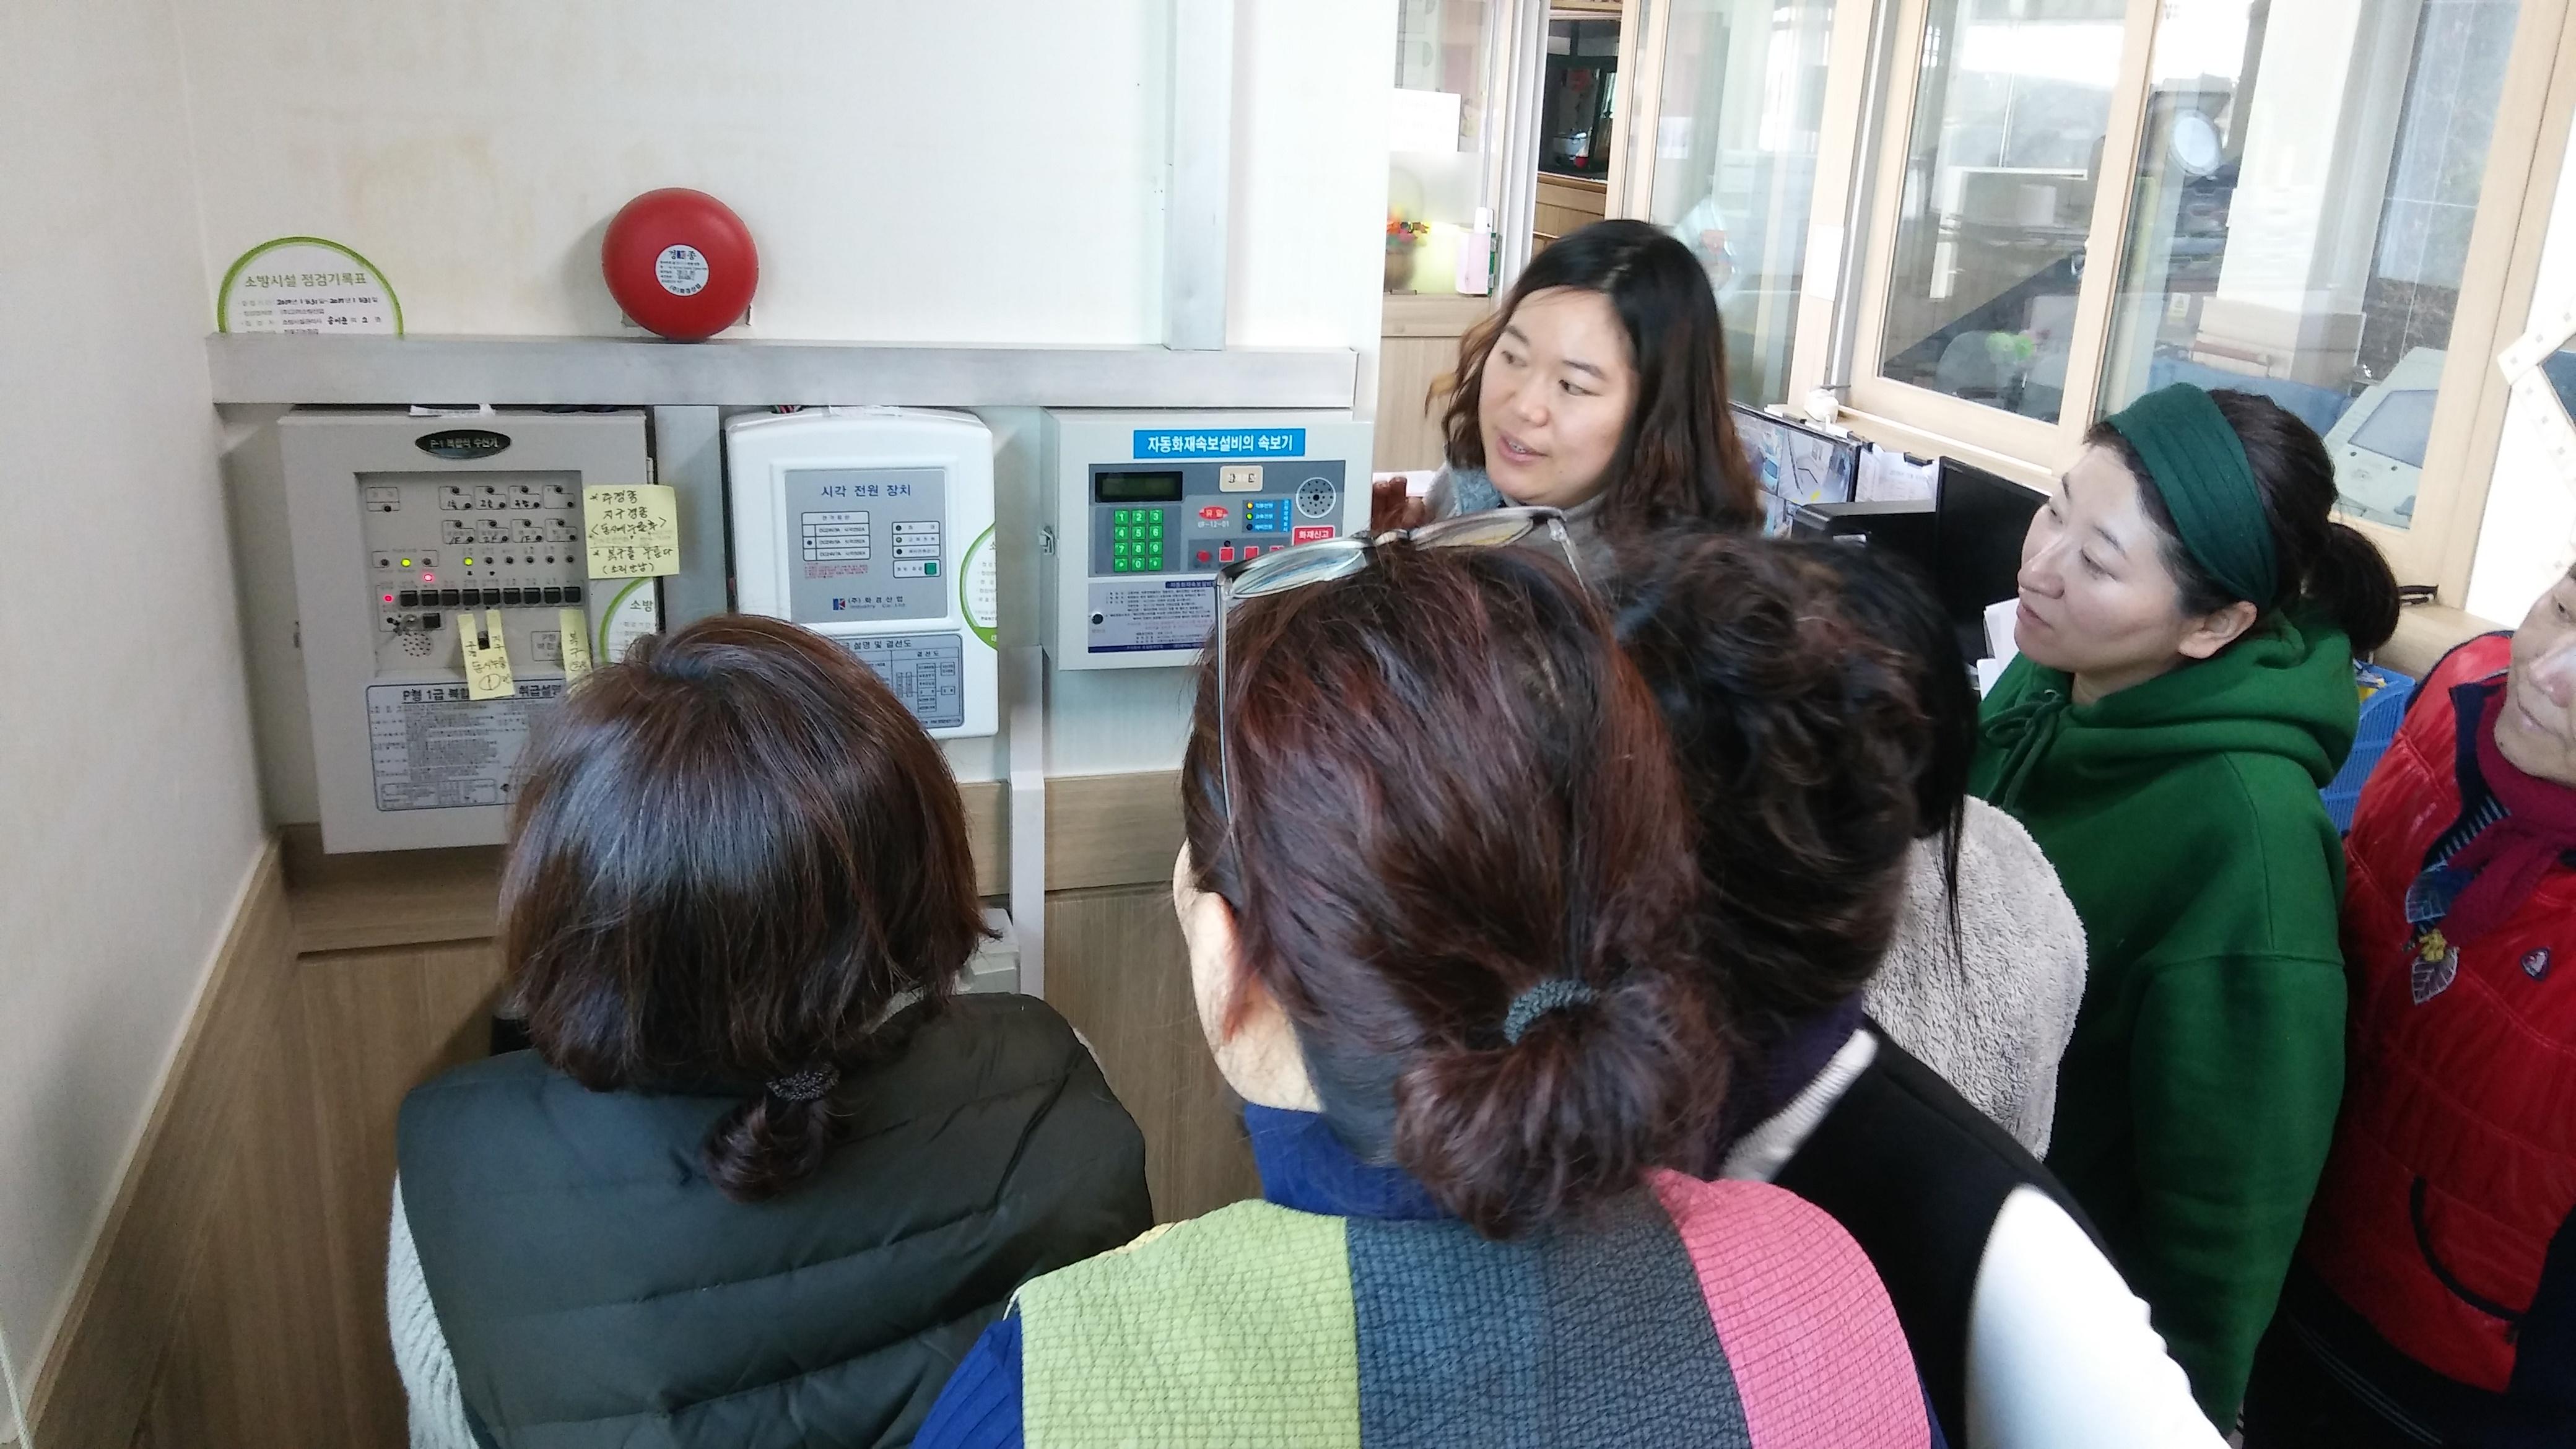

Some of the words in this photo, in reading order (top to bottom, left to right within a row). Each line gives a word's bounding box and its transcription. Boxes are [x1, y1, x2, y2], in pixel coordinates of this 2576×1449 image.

[245, 274, 296, 287] 소방시설
[302, 273, 366, 287] 점검기록표
[430, 439, 444, 448] P-1
[1147, 435, 1254, 453] 자동화재속보설비의
[1258, 435, 1293, 452] 속보기
[822, 485, 846, 497] 시각
[855, 484, 879, 497] 전원
[887, 484, 911, 497] 장치
[1119, 513, 1124, 521] 1
[1136, 513, 1142, 521] 2
[1153, 512, 1159, 521] 3
[1118, 529, 1125, 537] 4
[1136, 529, 1141, 537] 5
[1152, 528, 1159, 537] 6
[1299, 530, 1329, 539] 화재신고
[1119, 545, 1125, 554] 7
[1135, 544, 1141, 553] 8
[1152, 544, 1159, 552] 9
[1135, 560, 1141, 568] 0
[854, 642, 870, 650] 설명
[874, 640, 882, 649] 및
[886, 640, 912, 648] 결선도
[403, 689, 422, 701] P형
[427, 689, 445, 700] 1급
